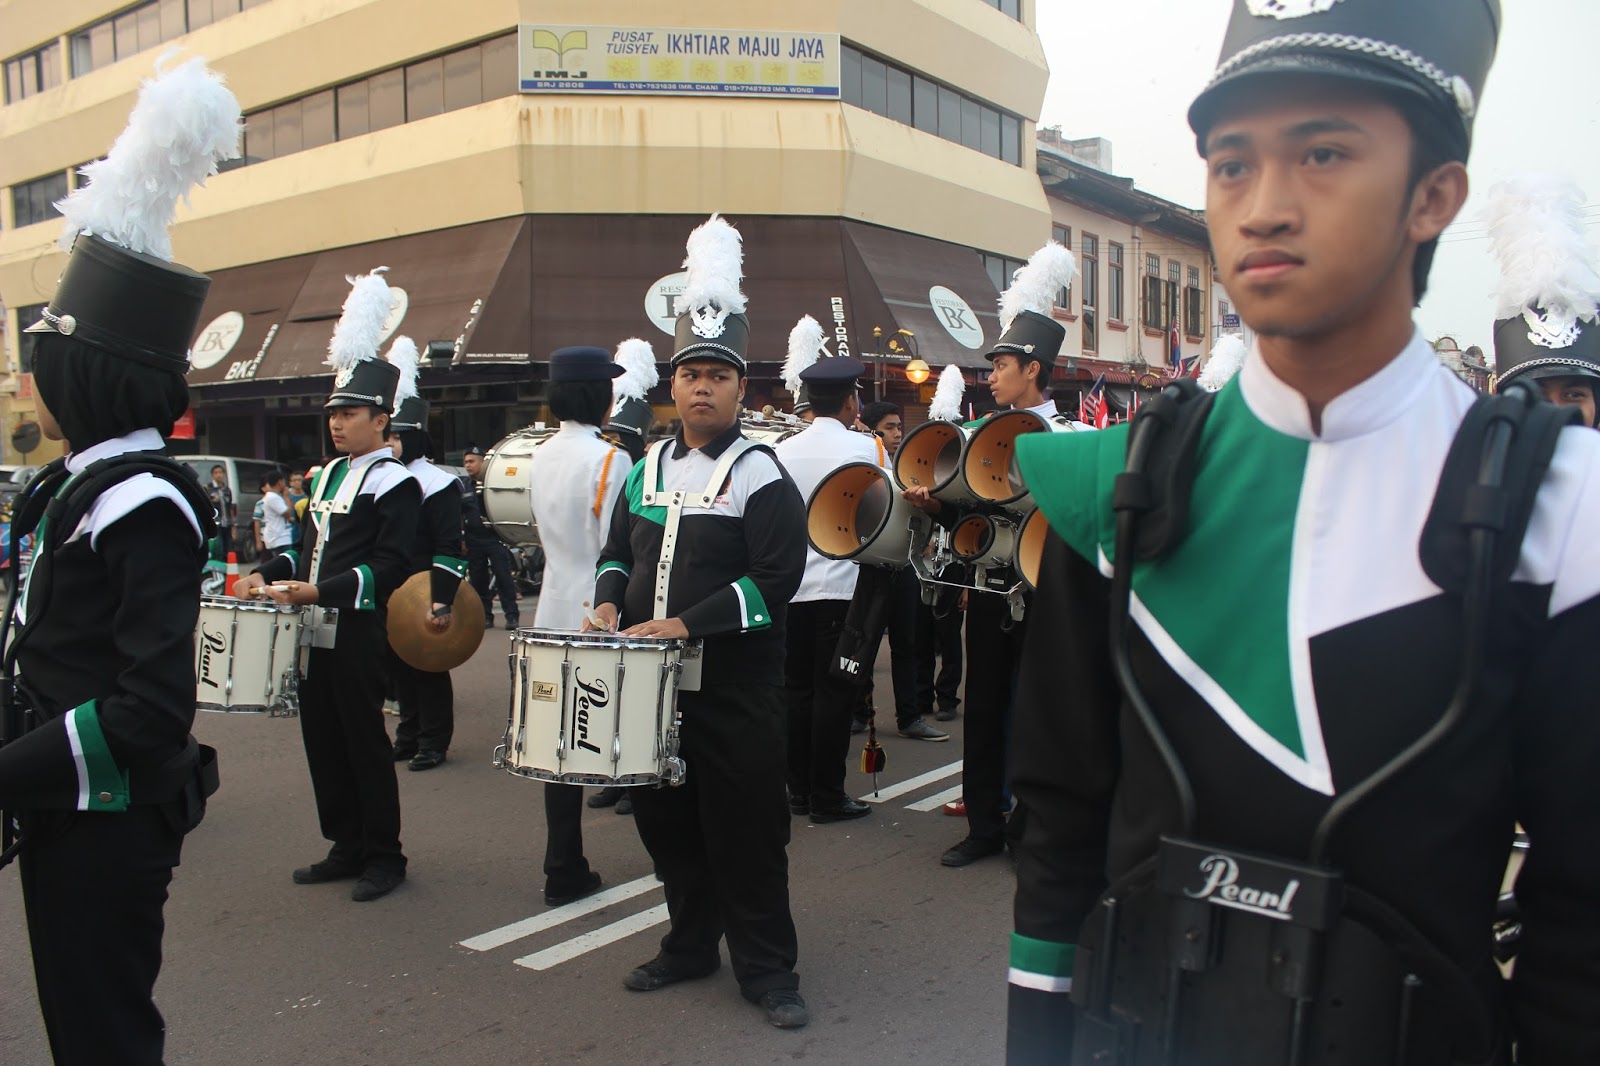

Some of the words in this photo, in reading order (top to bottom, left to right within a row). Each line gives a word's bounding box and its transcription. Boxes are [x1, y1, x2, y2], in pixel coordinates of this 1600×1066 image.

[606, 43, 659, 54] TUISYEN
[612, 31, 653, 43] PUSAT
[667, 33, 730, 56] IKHTIAR
[738, 36, 780, 57] MAJU
[789, 37, 825, 60] JAYA
[533, 70, 588, 79] IMJ
[830, 296, 850, 357] RESTORAN
[937, 305, 978, 331] BK
[224, 359, 254, 381] BK
[199, 621, 227, 689] Pearl
[574, 666, 610, 755] Pearl
[1183, 854, 1300, 917] Pearl
